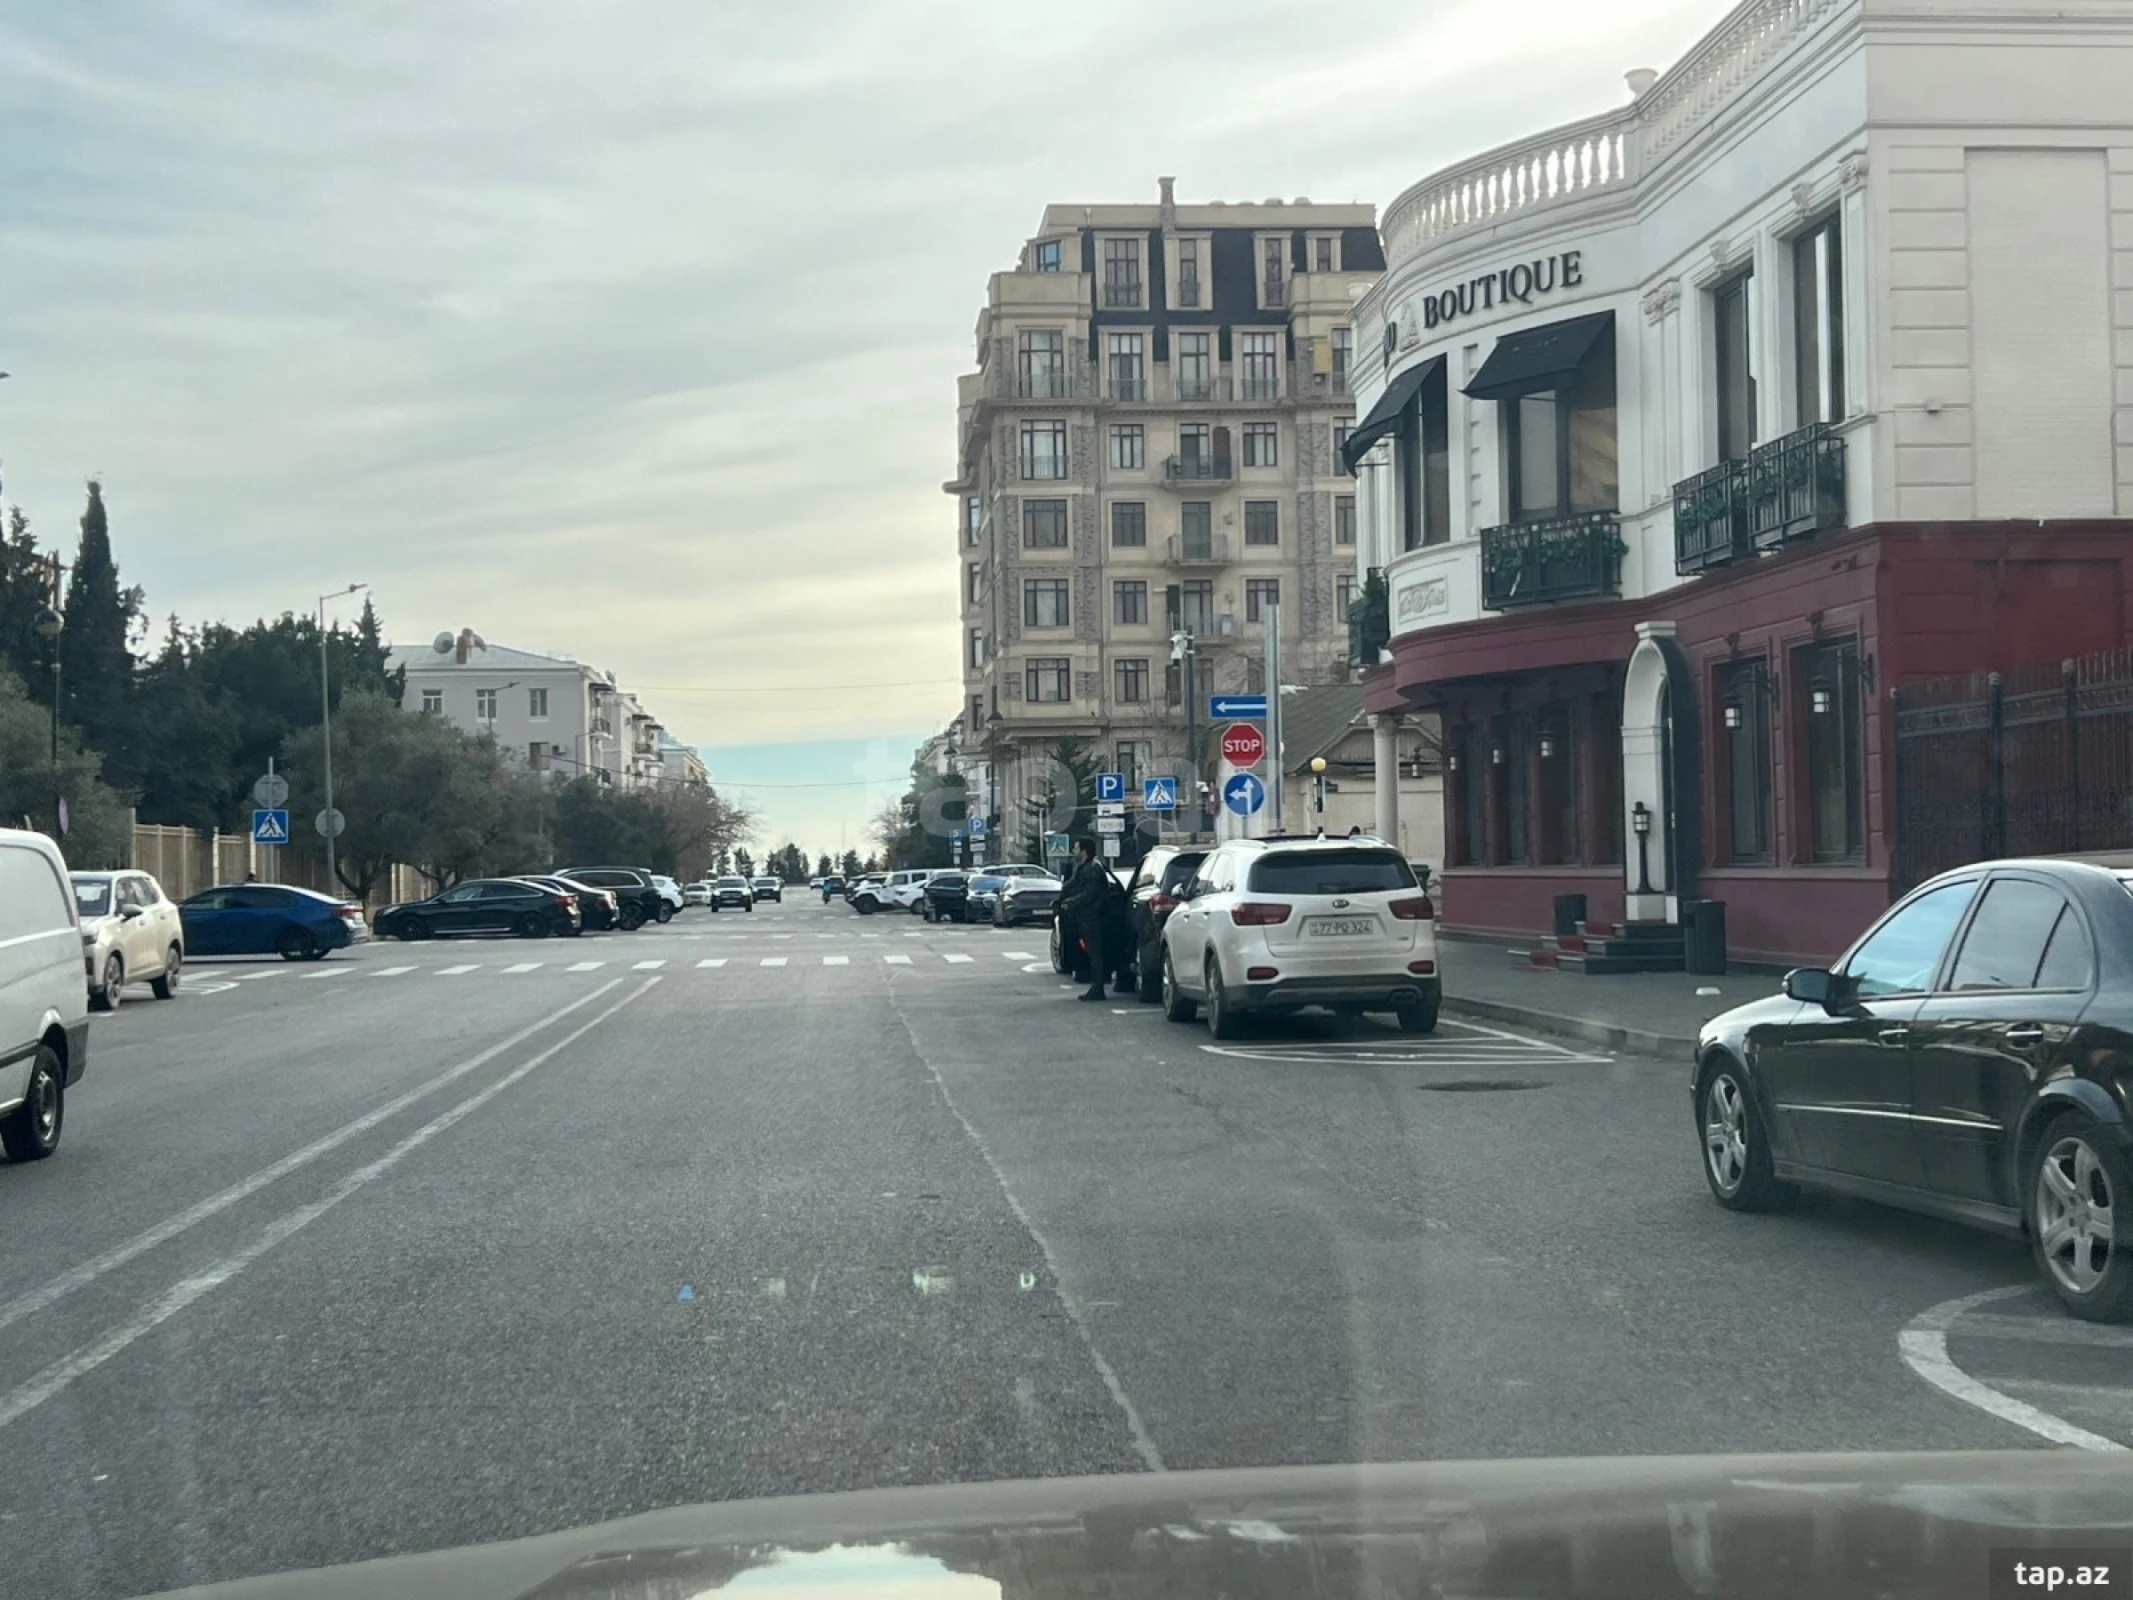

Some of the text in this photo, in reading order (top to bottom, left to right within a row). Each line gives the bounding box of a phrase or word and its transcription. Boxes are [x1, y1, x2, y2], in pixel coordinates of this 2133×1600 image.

[1423, 250, 1583, 329] BOUTIQUE
[1223, 739, 1261, 752] STOP
[1103, 776, 1117, 798] P
